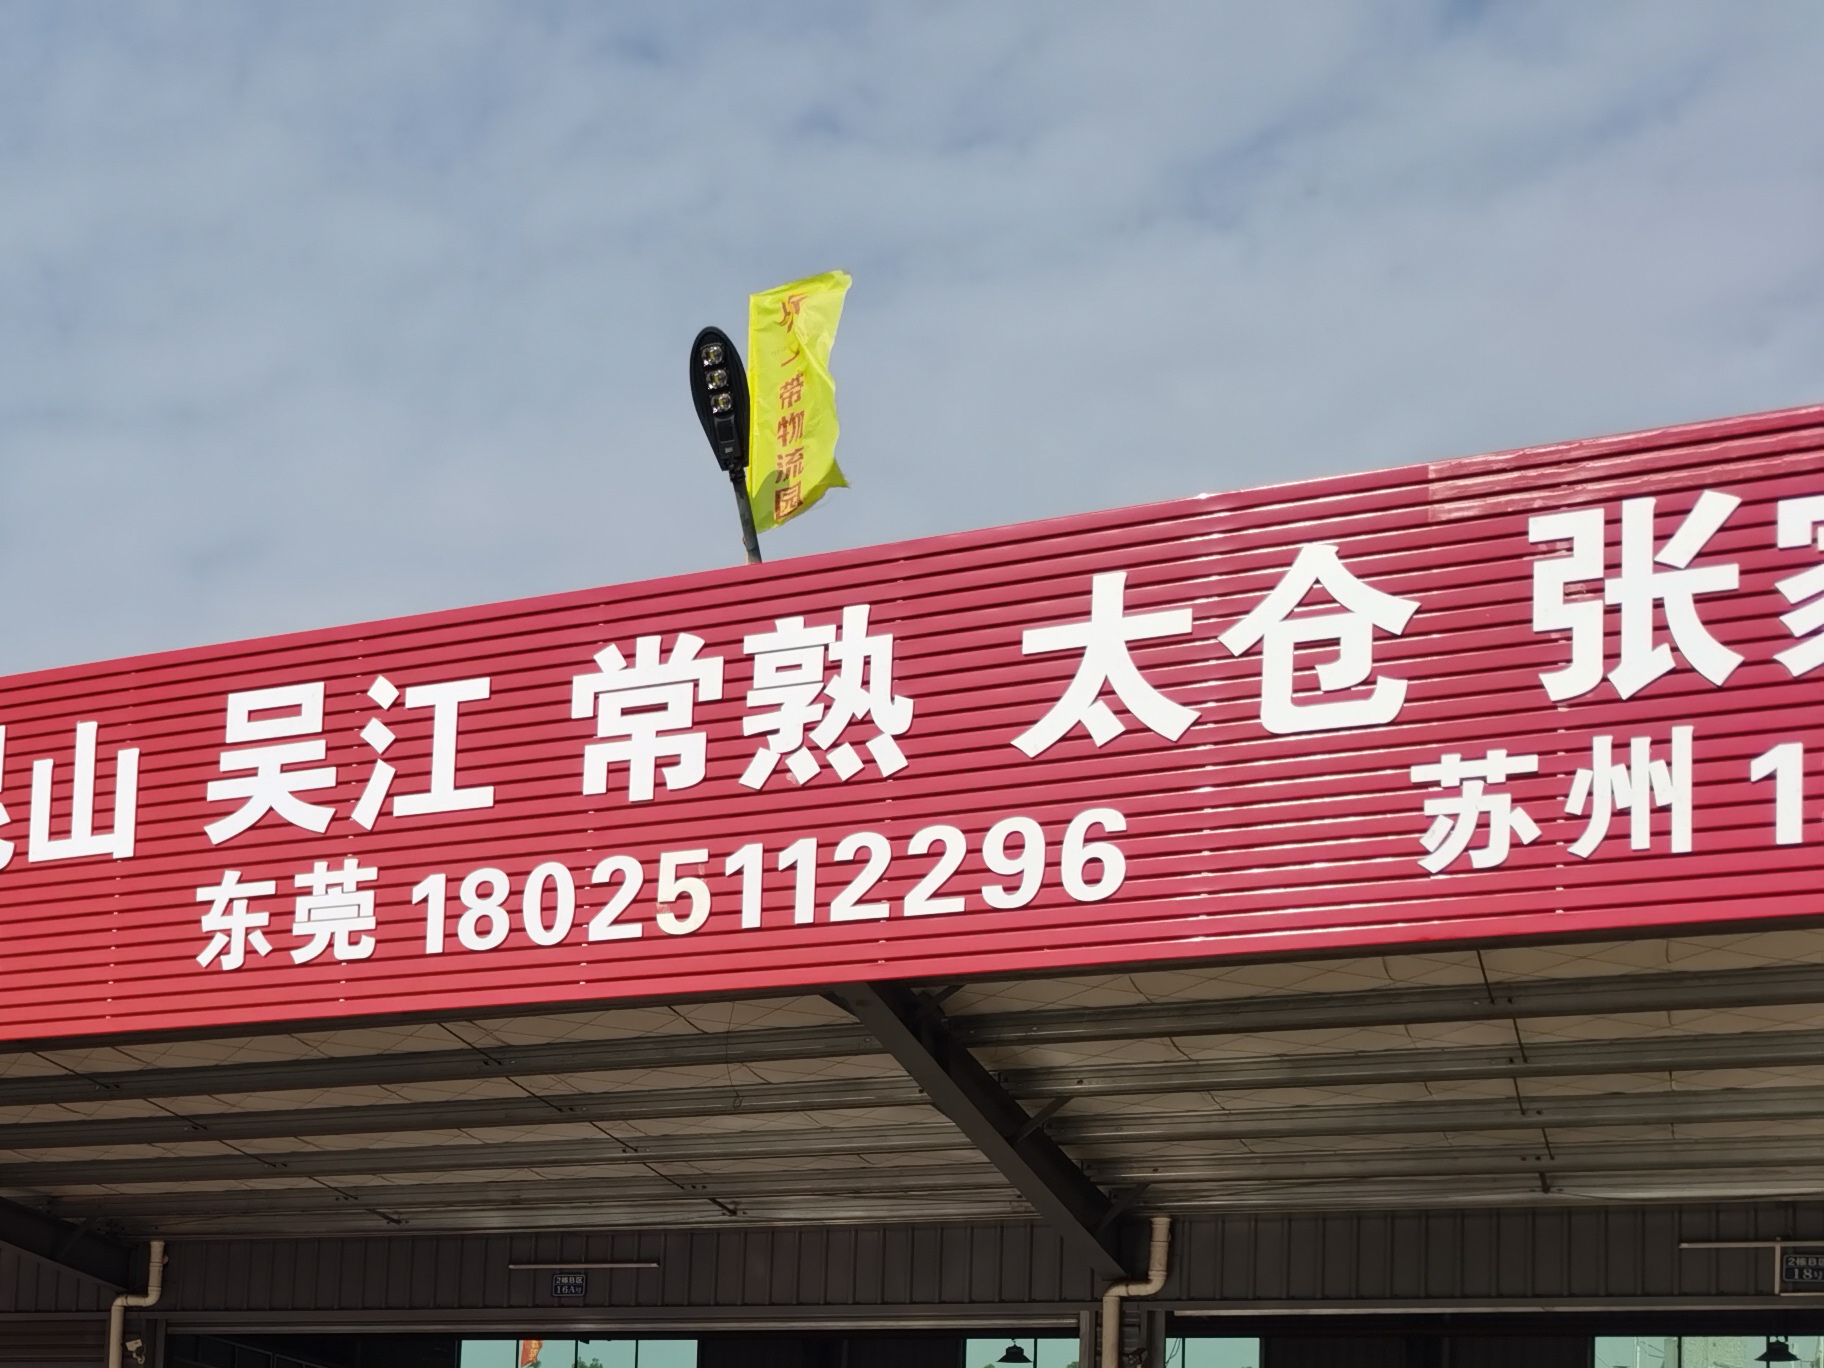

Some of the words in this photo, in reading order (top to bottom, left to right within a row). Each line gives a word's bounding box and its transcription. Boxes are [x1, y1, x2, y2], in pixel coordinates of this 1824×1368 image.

[204, 675, 495, 846] 吴江
[571, 604, 915, 803] 常熟
[1012, 541, 1421, 760] 太仓
[1410, 726, 1695, 874] 苏州
[196, 858, 379, 971] 东莞
[412, 807, 1128, 954] 18025112296
